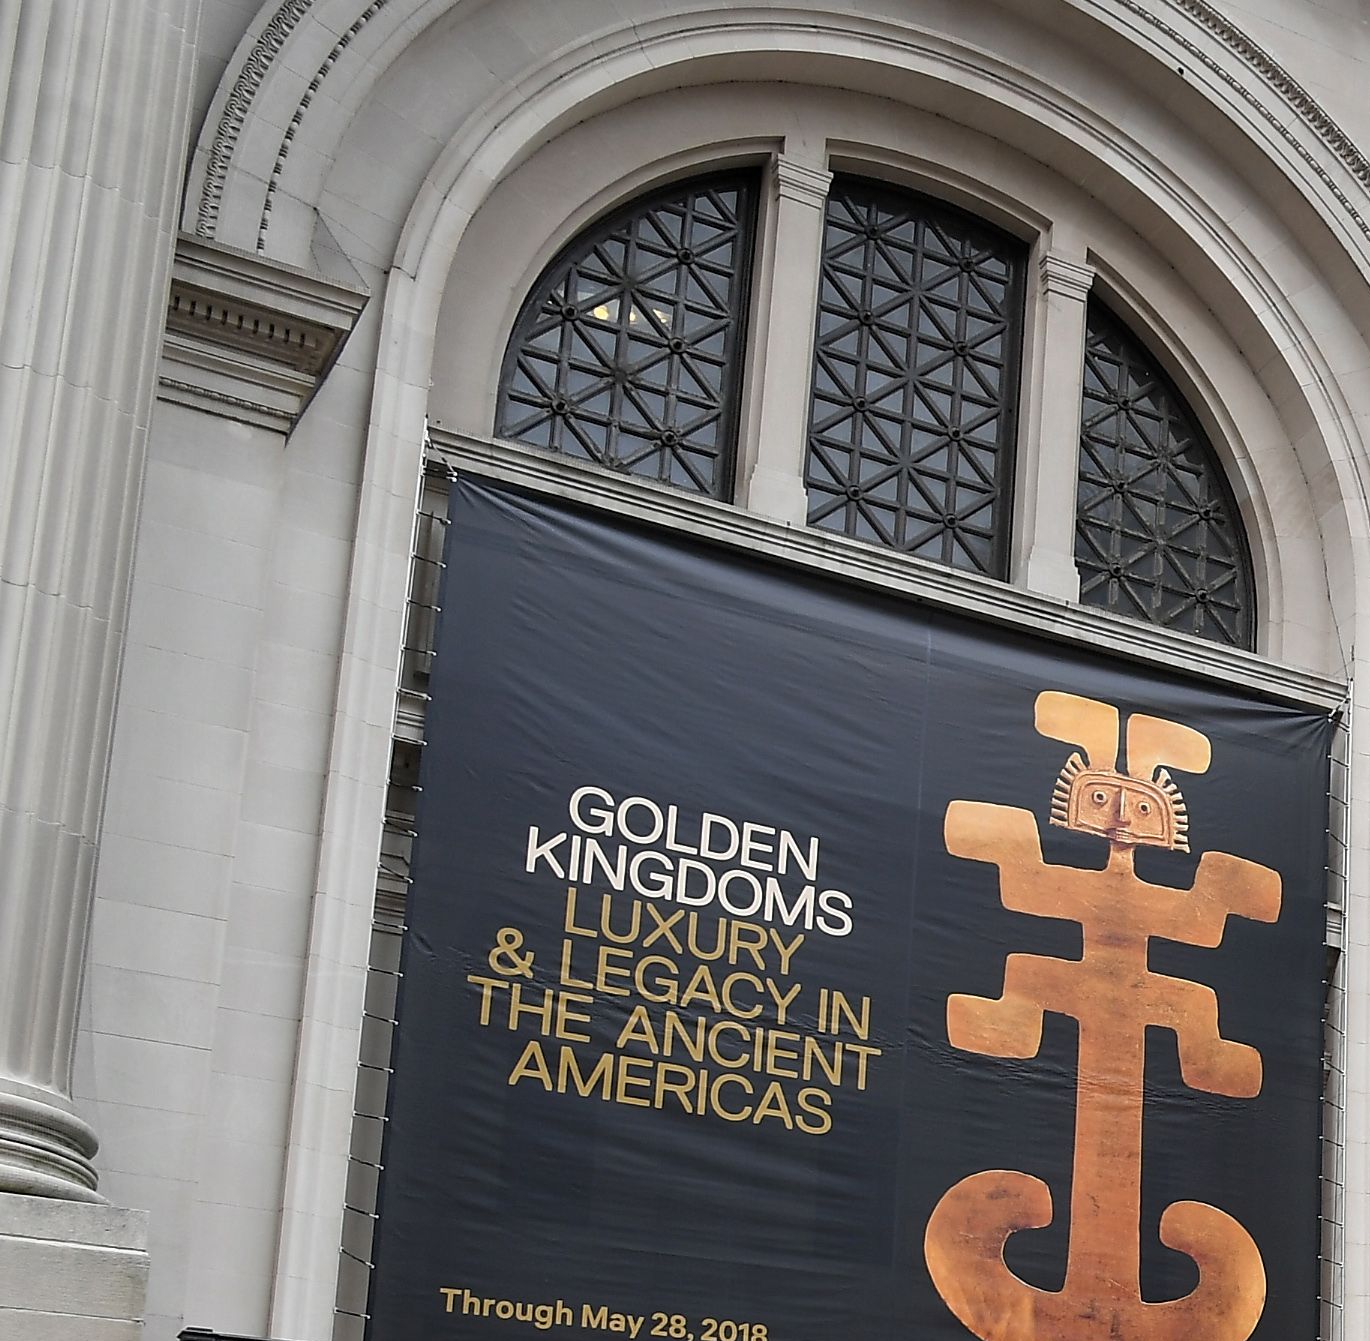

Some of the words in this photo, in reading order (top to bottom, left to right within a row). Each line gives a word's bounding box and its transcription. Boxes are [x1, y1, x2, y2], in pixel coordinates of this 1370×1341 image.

[524, 825, 854, 937] KINGDOMS
[568, 785, 819, 881] GOLDEN
[564, 886, 805, 976] LUXURY
[487, 926, 535, 979] &
[559, 937, 802, 1026] LEGACY
[817, 987, 872, 1041] IN
[466, 974, 594, 1043] THE
[615, 1004, 883, 1091] ANCIENT
[507, 1039, 833, 1135] AMERICAS
[439, 1286, 573, 1330] Through
[580, 1303, 645, 1340] May
